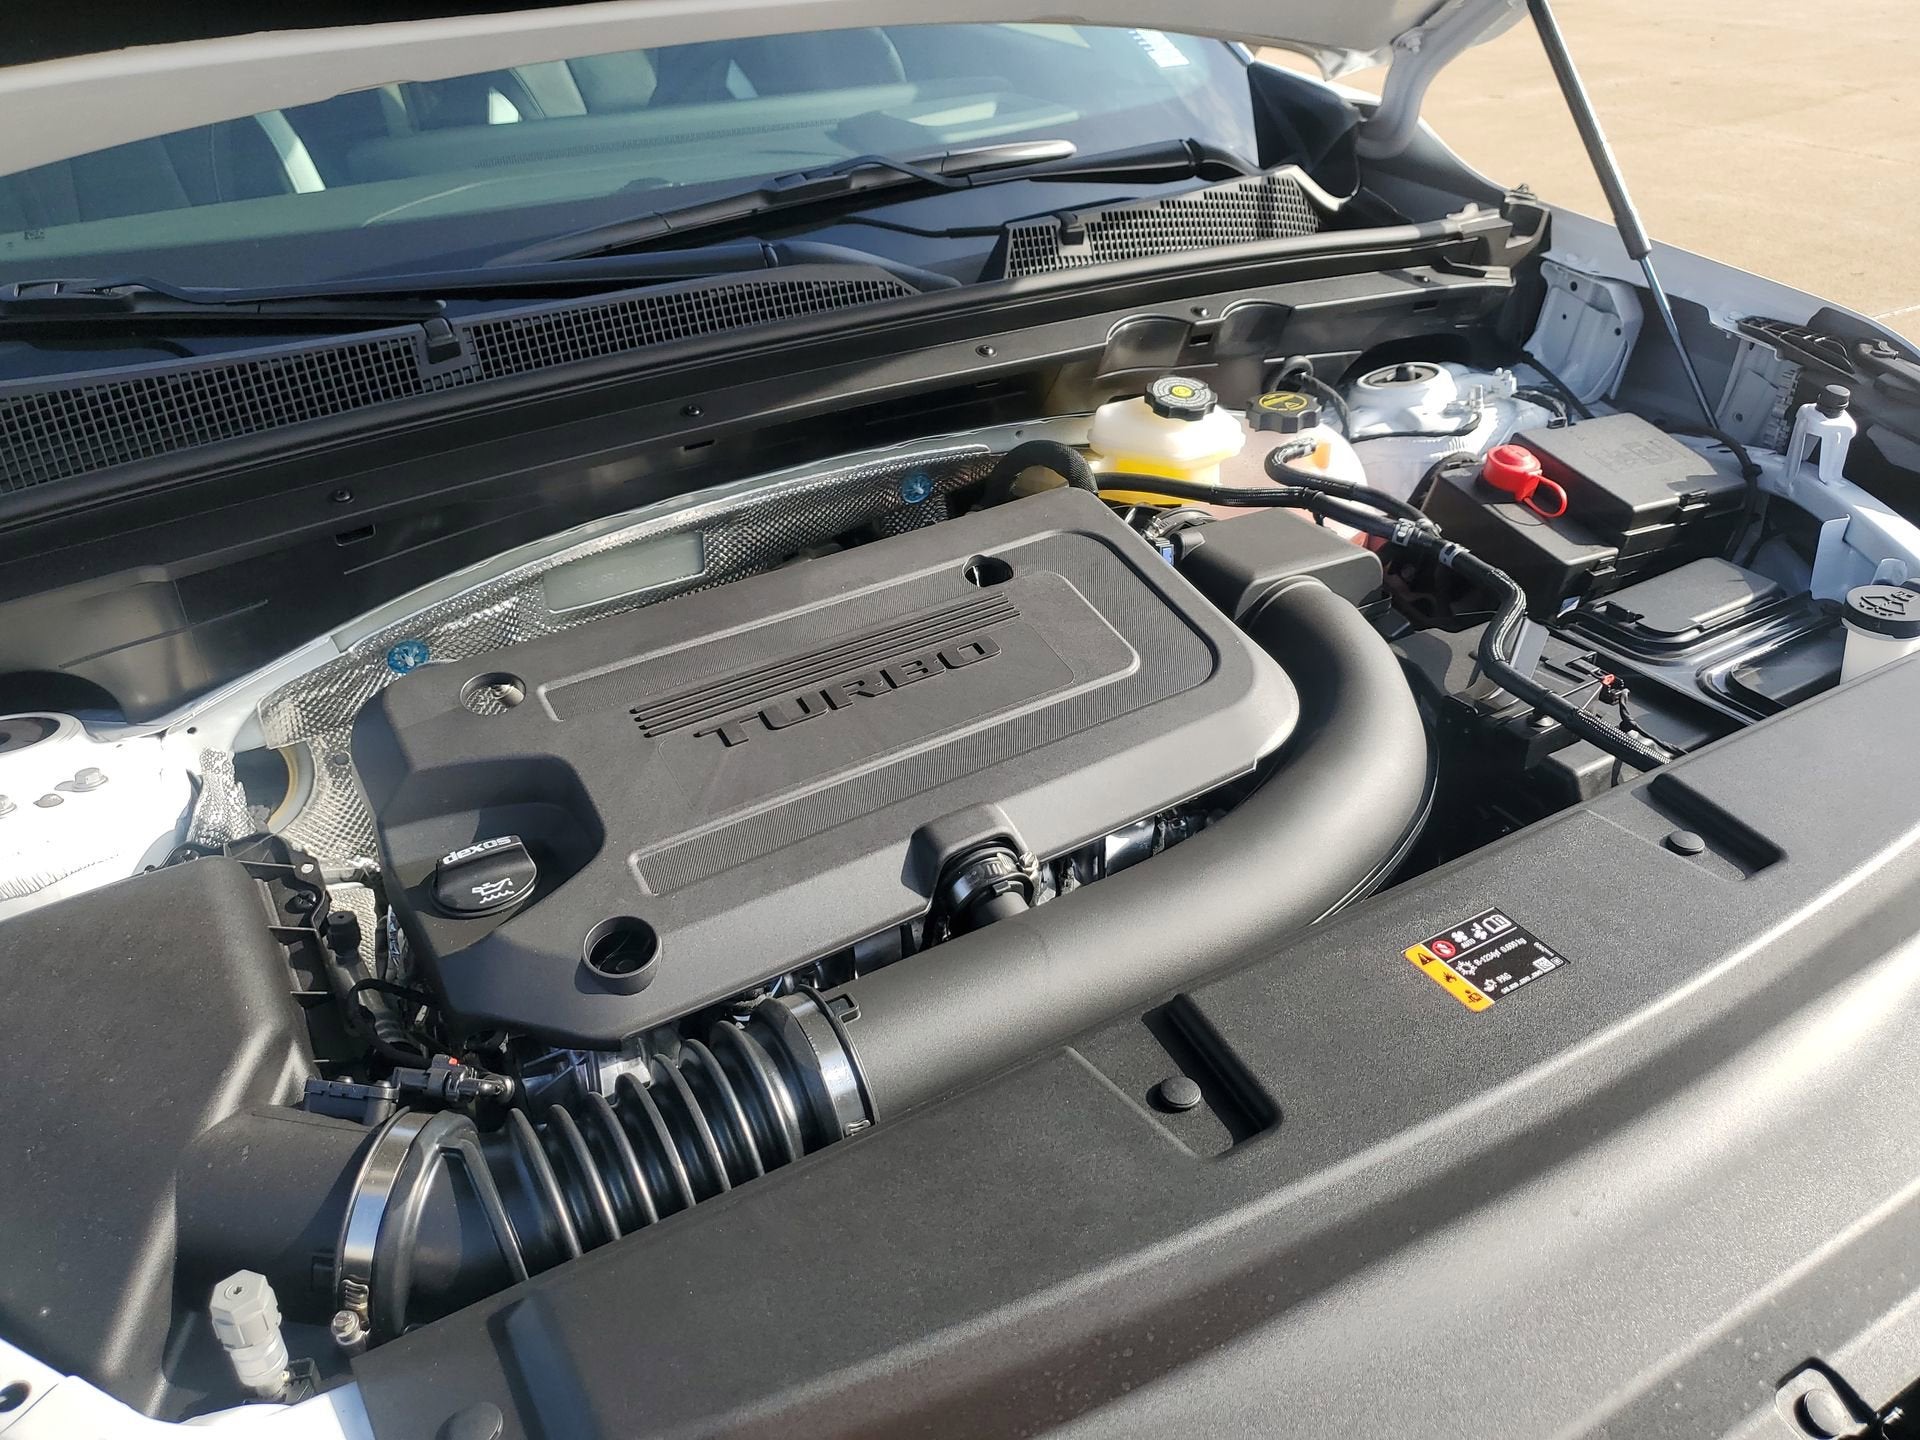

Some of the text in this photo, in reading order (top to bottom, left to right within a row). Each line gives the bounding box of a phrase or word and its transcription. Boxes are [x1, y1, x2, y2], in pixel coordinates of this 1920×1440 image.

[693, 635, 1001, 747] TURBO
[442, 836, 512, 865] dexos
[1460, 938, 1476, 949] AUTO
[1515, 937, 1527, 945] kg
[1496, 972, 1512, 984] PAG
